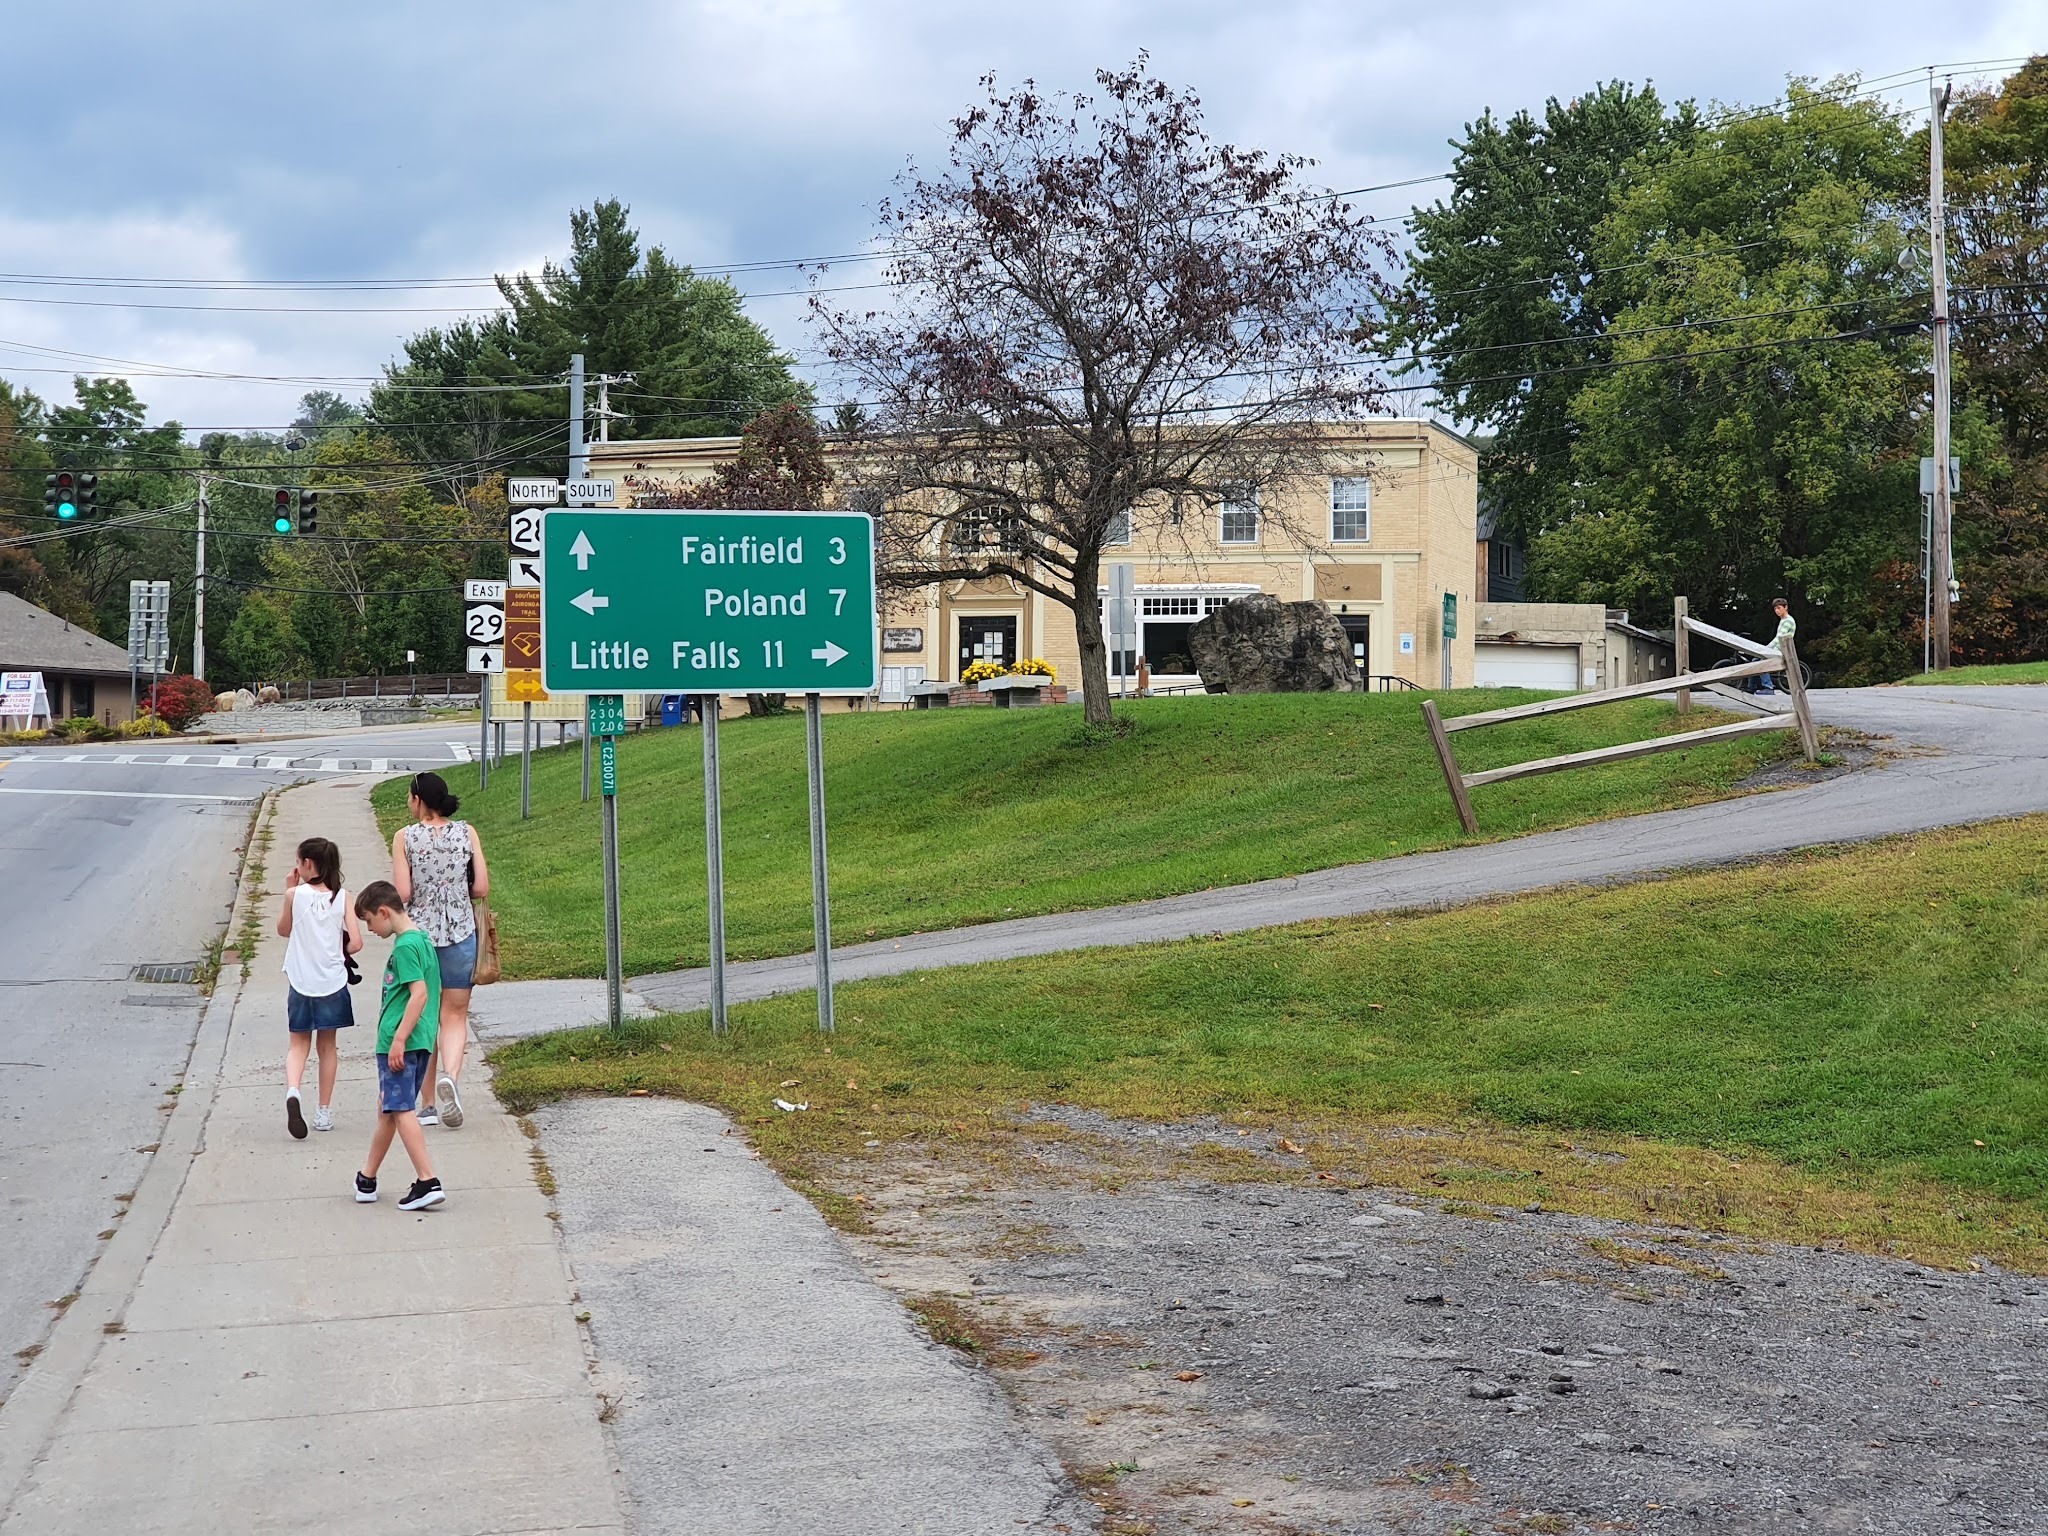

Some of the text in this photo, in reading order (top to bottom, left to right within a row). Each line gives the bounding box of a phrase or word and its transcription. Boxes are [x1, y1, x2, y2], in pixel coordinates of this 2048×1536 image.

[512, 484, 555, 498] NORTH
[570, 484, 612, 498] SOUTH
[682, 536, 847, 565] Fairfield 3
[472, 584, 500, 597] EAST
[705, 588, 847, 617] Poland 7
[469, 614, 503, 636] 29
[571, 640, 783, 670] Little Falls 11
[599, 696, 614, 706] 28
[590, 708, 624, 720] 2304
[592, 721, 624, 733] 1206
[602, 747, 614, 789] C230071
